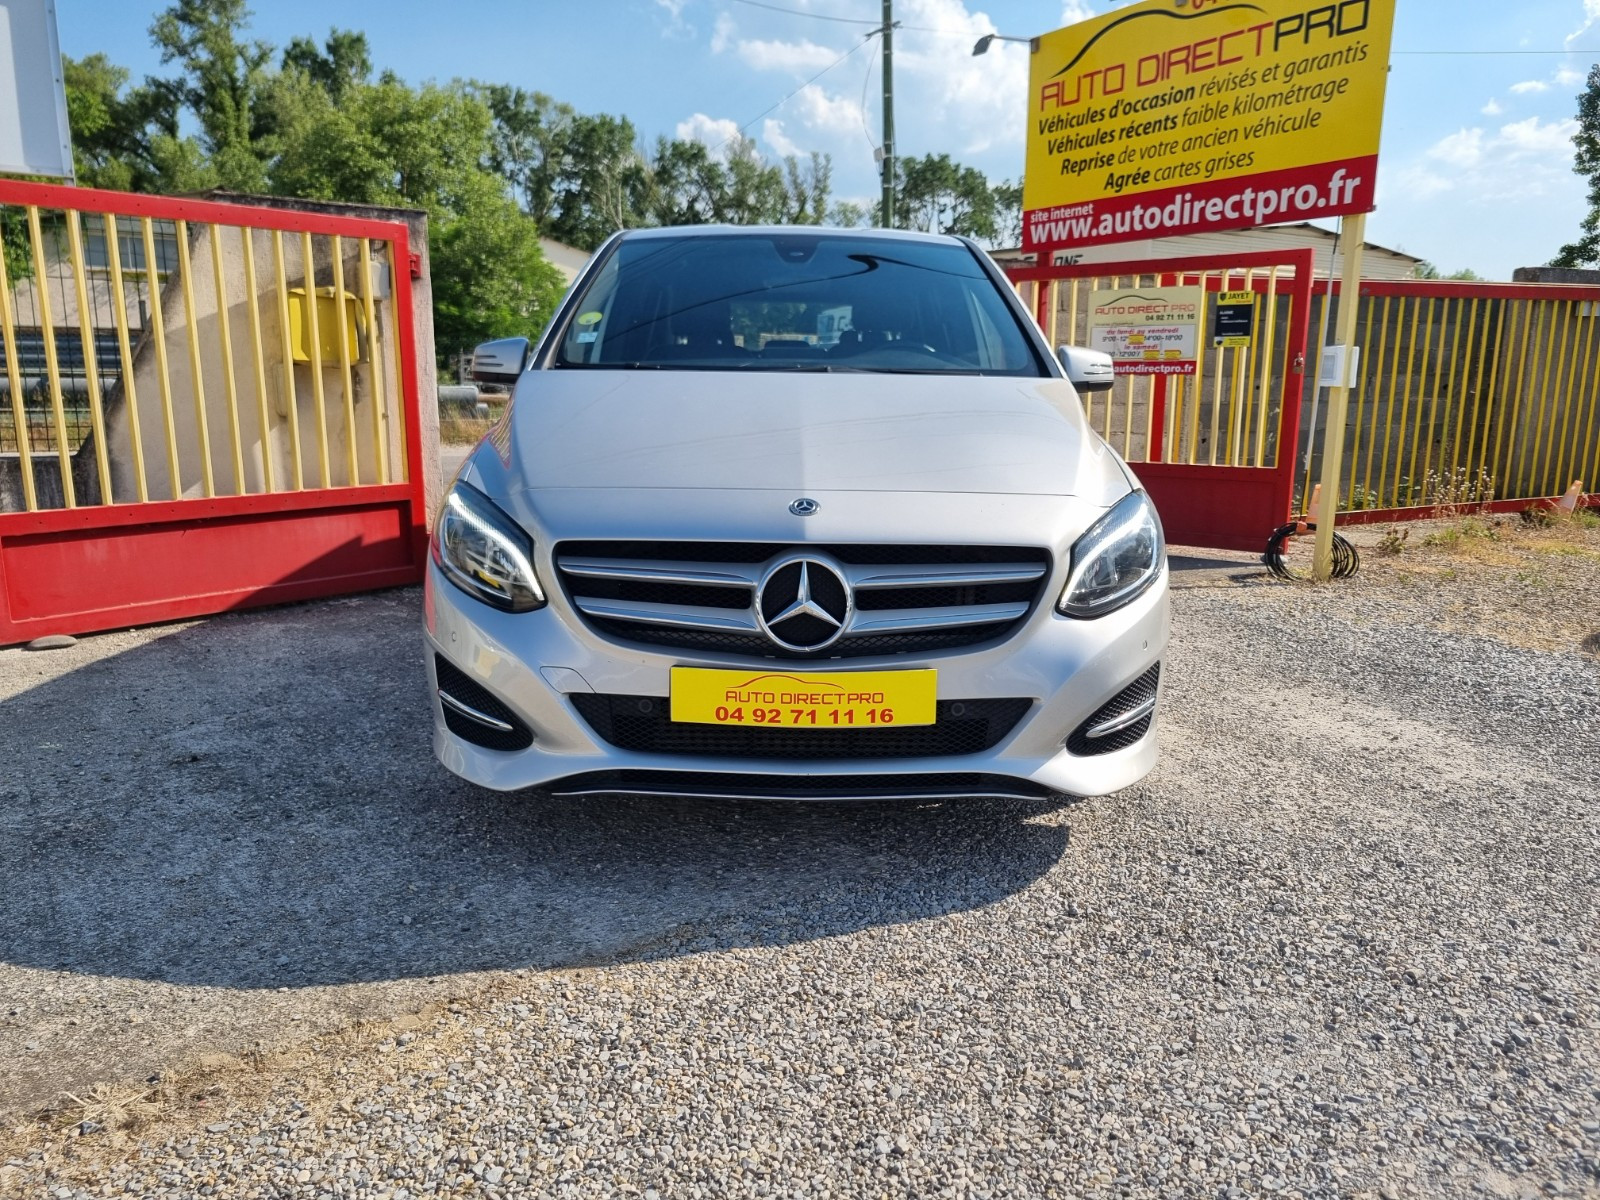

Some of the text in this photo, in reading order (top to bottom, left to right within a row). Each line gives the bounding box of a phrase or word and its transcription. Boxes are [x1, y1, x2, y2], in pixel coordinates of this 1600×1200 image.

[1038, 41, 1369, 135] Véhicules d'occasion révisés et garantis
[1041, 64, 1125, 112] AUTO
[1047, 76, 1350, 156] Véhicules récents faible kilométrage
[1060, 107, 1322, 176] Reprise de votre ancien véhicule
[1103, 151, 1255, 193] Agrée cartes grises
[1030, 169, 1361, 244] www.autodirectpro.fr
[1030, 203, 1094, 223] site internet
[1095, 307, 1125, 316] AUTO
[1228, 292, 1250, 300] JAYET
[1117, 328, 1135, 336] lundi
[725, 690, 775, 704] AUTO
[715, 706, 894, 724] 04 92 71 11 16
